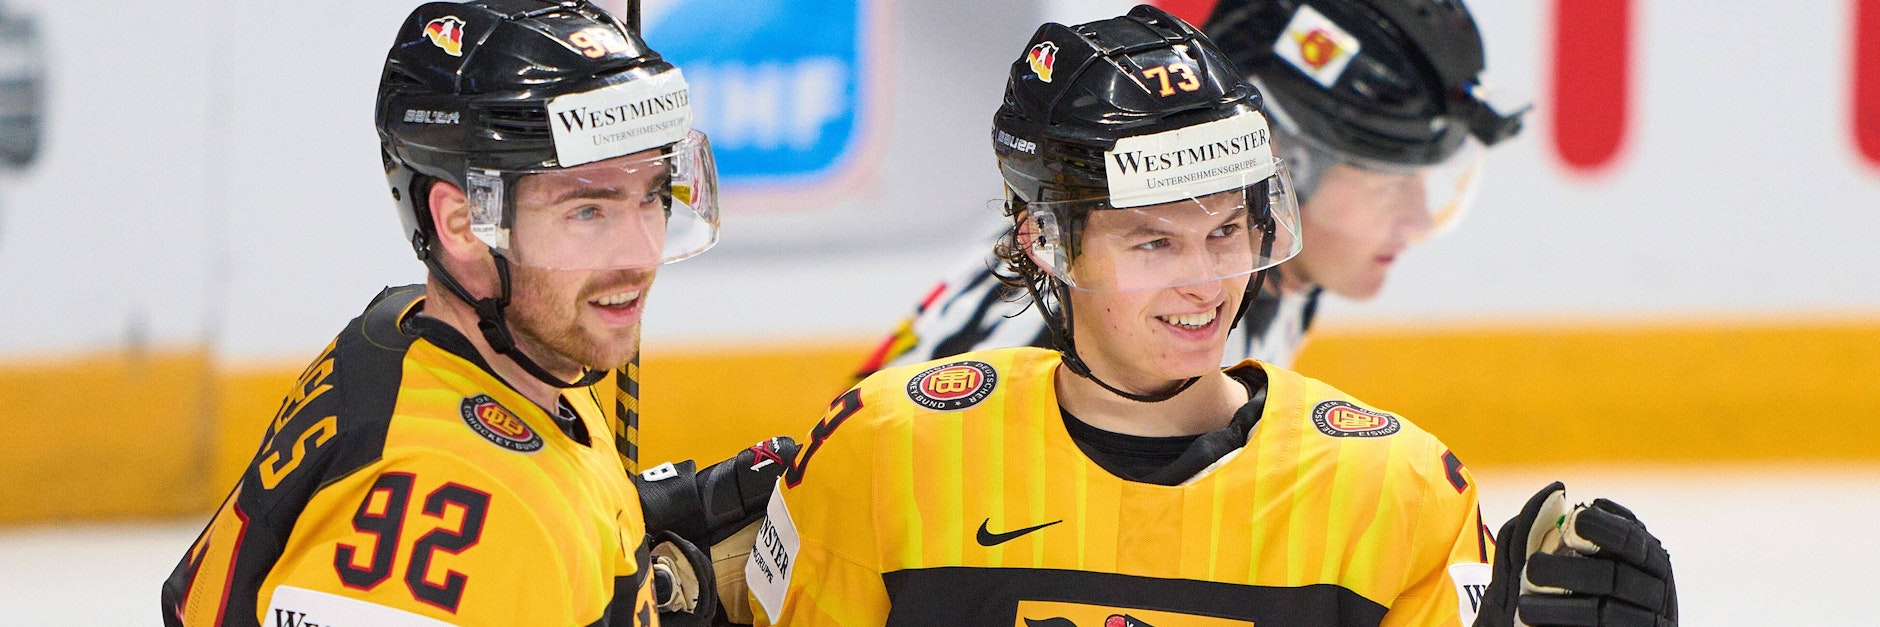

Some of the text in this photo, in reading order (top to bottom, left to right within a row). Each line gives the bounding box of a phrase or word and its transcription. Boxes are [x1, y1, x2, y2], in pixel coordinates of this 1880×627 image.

[1142, 62, 1200, 97] 73
[997, 130, 1037, 155] BAUER
[1113, 128, 1266, 176] WESTMINSTER
[1146, 158, 1258, 190] UNTERNEHMENSGRUPPE
[333, 471, 492, 615] 92
